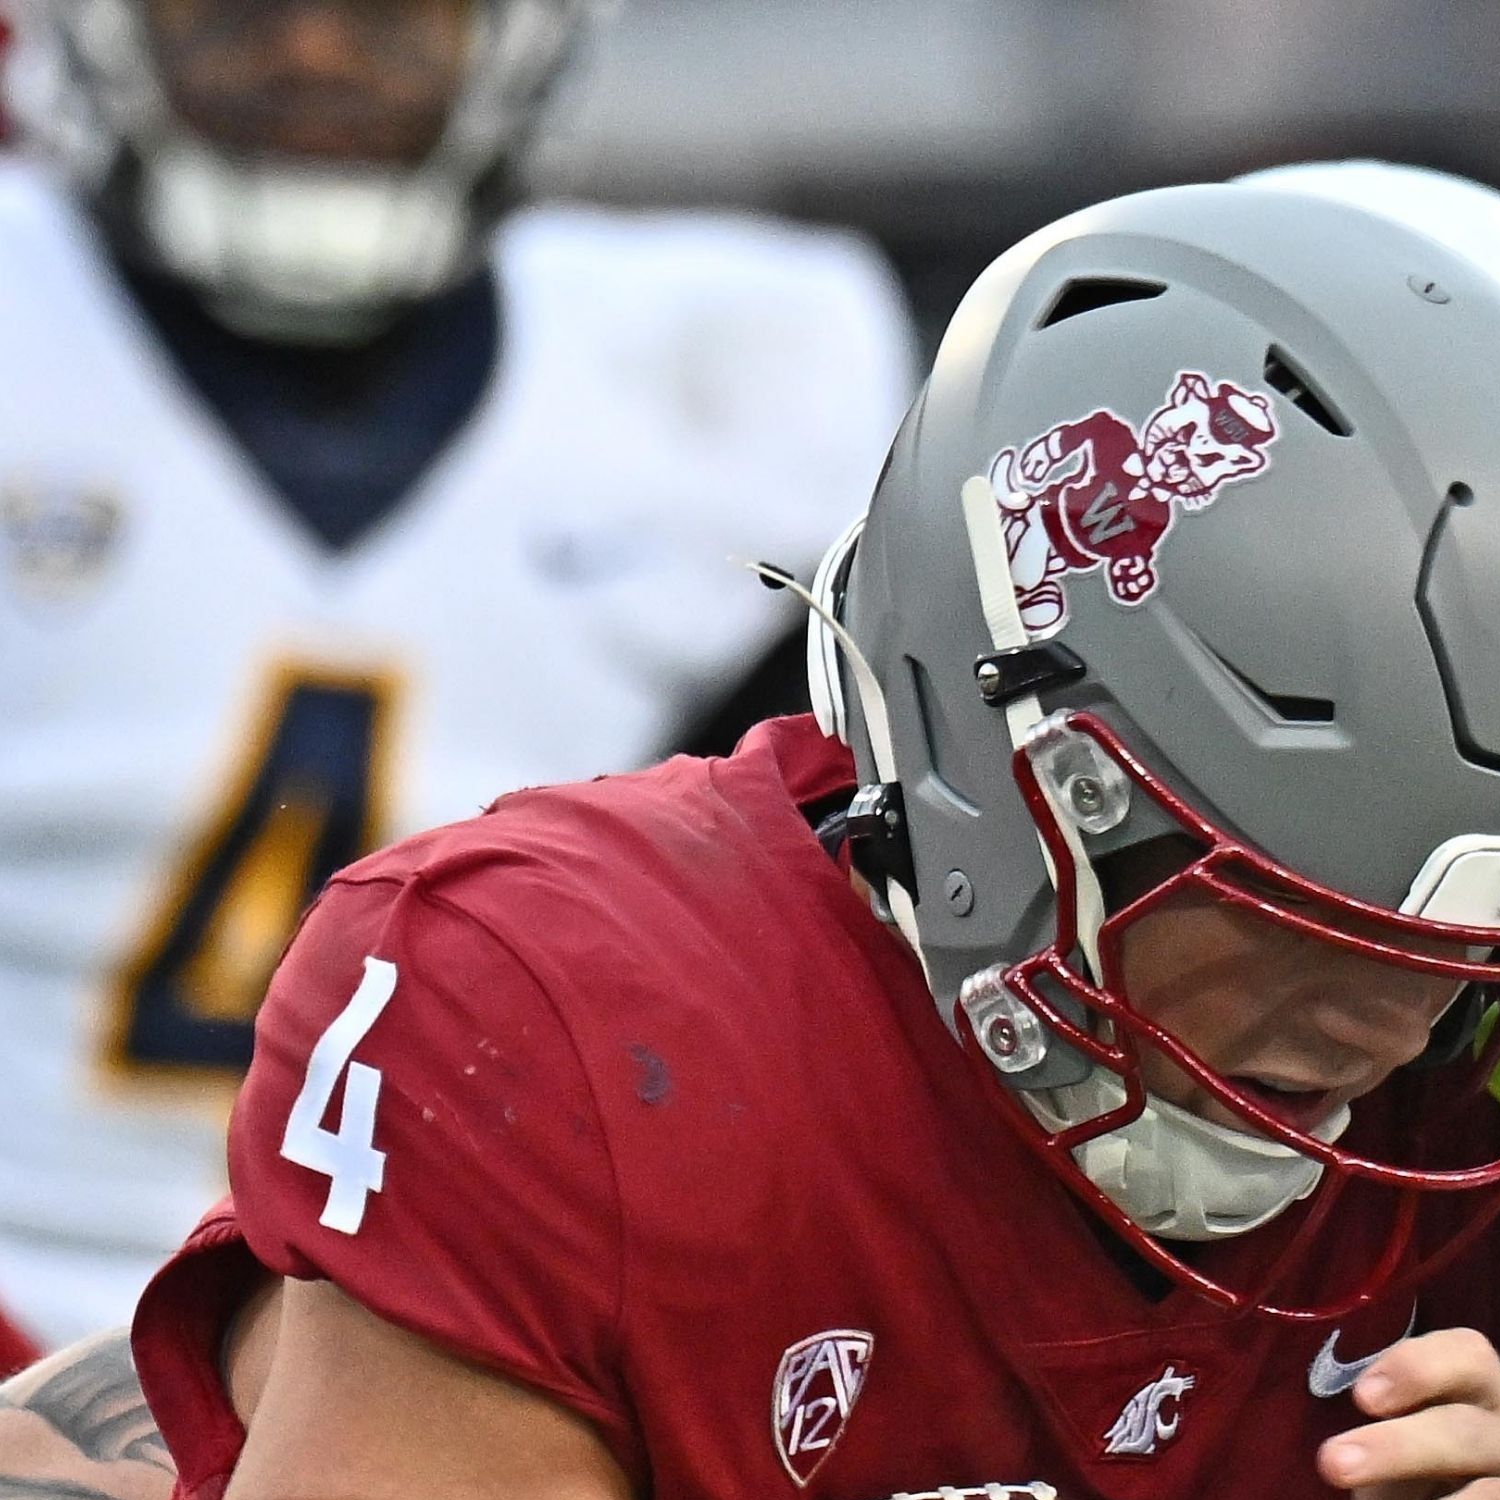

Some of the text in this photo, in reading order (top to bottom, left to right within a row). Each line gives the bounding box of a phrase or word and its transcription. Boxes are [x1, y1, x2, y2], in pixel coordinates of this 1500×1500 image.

[1080, 480, 1137, 546] W
[280, 955, 397, 1235] 4
[780, 1339, 868, 1430] PAC
[787, 1396, 838, 1456] 12
